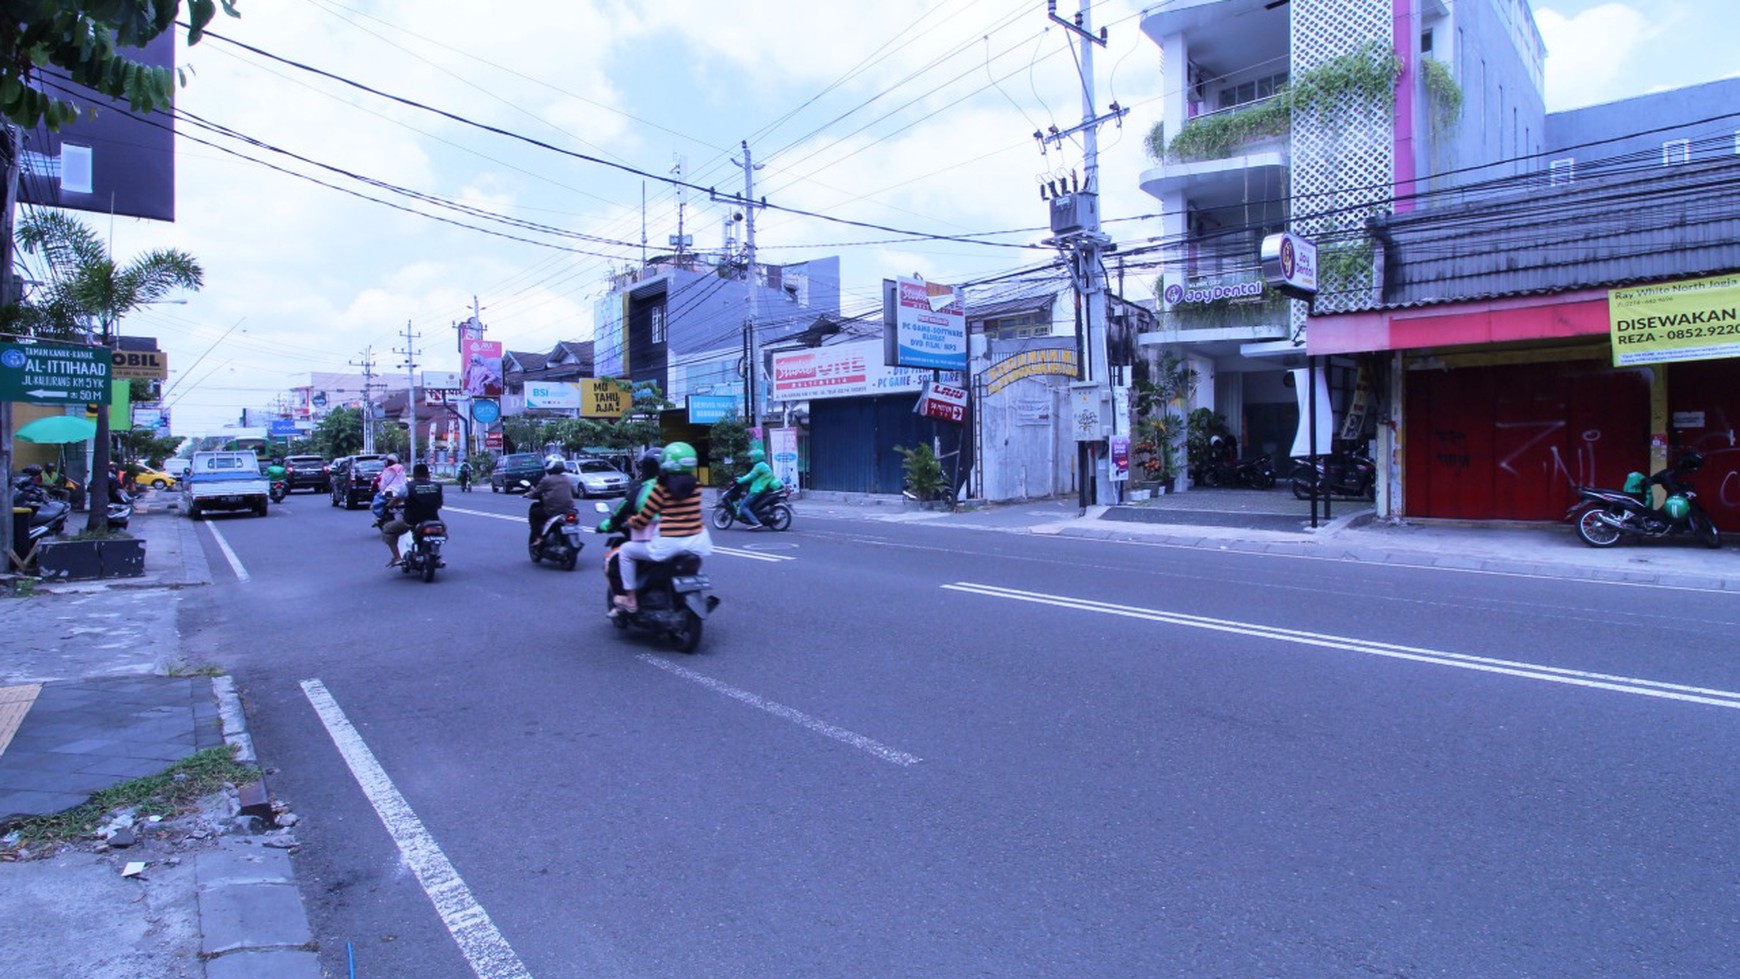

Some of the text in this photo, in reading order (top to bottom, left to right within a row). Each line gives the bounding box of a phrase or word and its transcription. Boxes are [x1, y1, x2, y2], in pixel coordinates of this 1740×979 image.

[1184, 288, 1213, 304] Joy
[1213, 281, 1263, 299] Dental
[1615, 278, 1737, 300] Ray White North Jogja
[902, 322, 911, 330] PC
[1617, 308, 1737, 332] DISEWAKAN
[1618, 332, 1656, 345] REZA
[25, 358, 106, 377] AL-ITTIHAAD
[73, 376, 85, 387] KM
[86, 377, 92, 389] 5
[877, 379, 888, 389] PC
[889, 376, 911, 388] GAME
[79, 390, 92, 400] 50
[93, 391, 102, 400] M
[594, 392, 619, 403] TAHU
